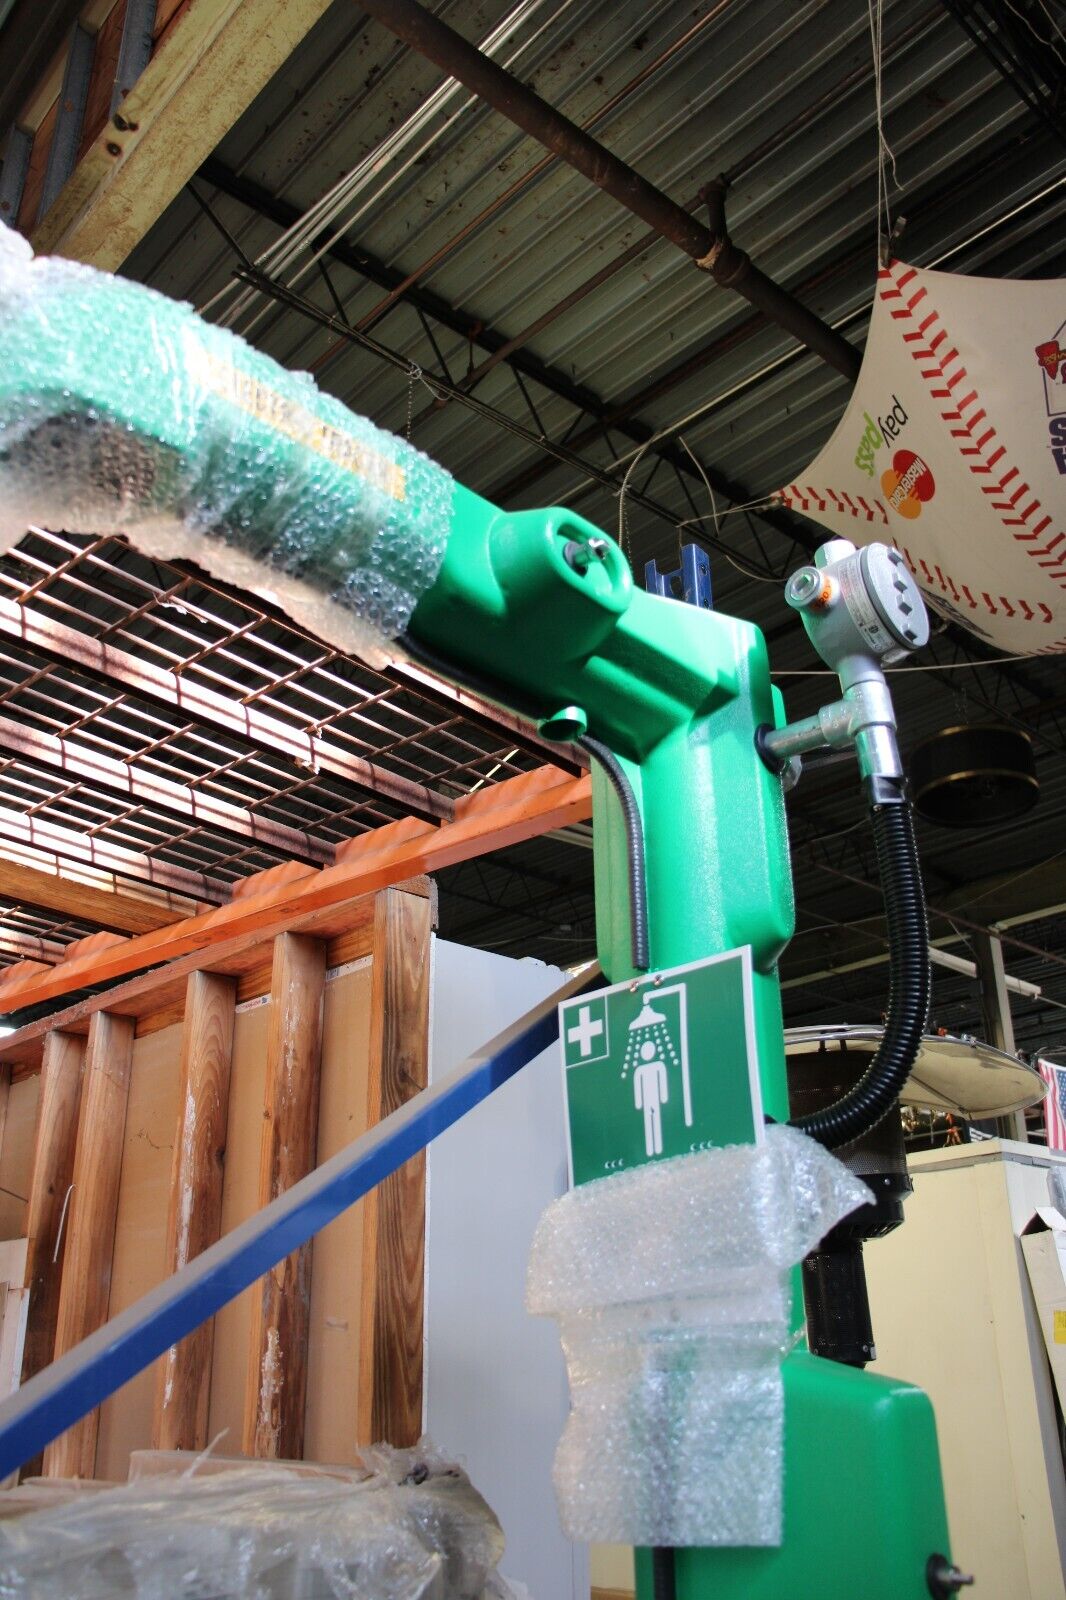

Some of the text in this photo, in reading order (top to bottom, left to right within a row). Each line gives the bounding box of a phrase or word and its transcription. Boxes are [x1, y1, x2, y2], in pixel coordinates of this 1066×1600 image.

[854, 394, 908, 477] pay pass
[889, 456, 927, 510] MasterCard
